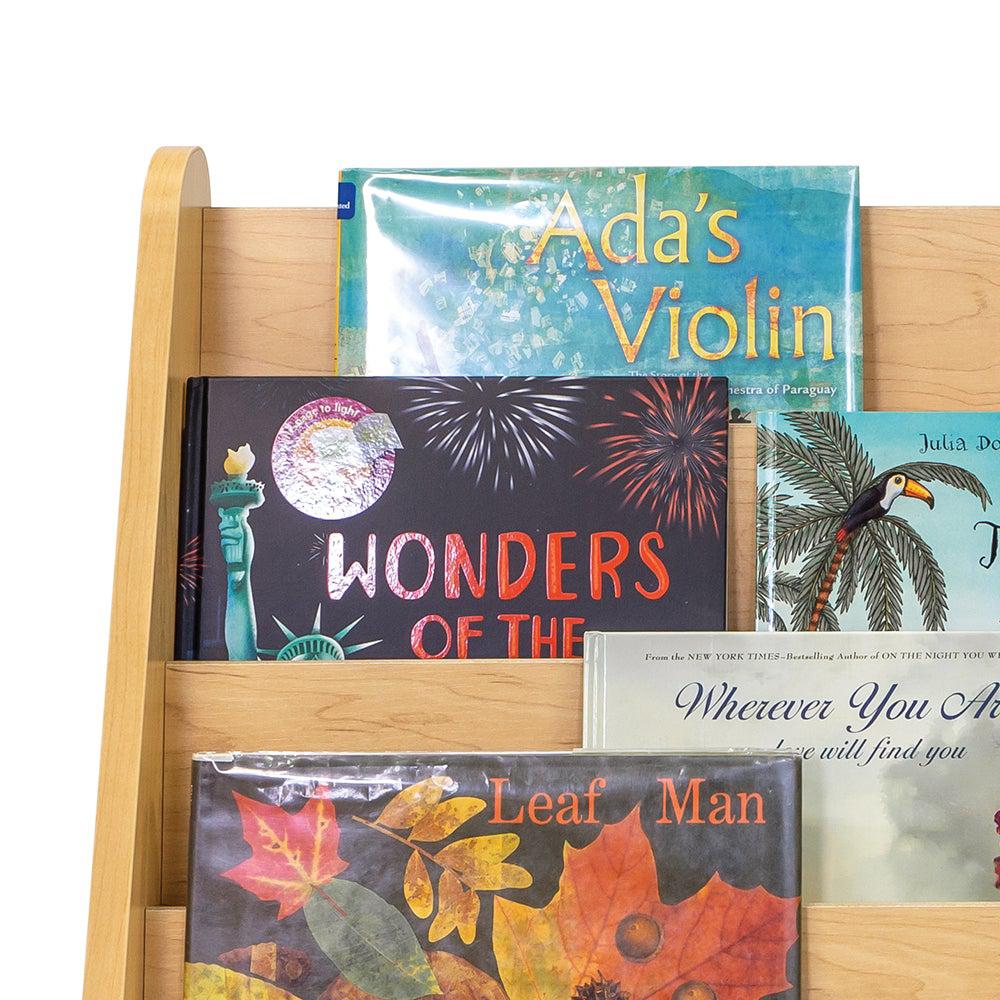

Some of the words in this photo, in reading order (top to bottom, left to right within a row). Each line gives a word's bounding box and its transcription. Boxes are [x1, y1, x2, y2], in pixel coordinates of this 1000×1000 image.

[523, 173, 741, 271] Ada's
[591, 275, 835, 363] Violin
[766, 384, 780, 395] of
[782, 384, 837, 397] Paraguay
[919, 433, 967, 454] Julia
[326, 531, 670, 600] WONDERS
[409, 614, 485, 660] OF
[645, 652, 668, 661] From
[671, 652, 685, 661] the
[687, 652, 711, 661] NEW
[715, 652, 744, 661] YORK
[837, 652, 868, 661] Author
[870, 651, 880, 660] of
[882, 651, 897, 660] ON
[901, 651, 922, 660] THE
[925, 651, 959, 660] NIGHT
[962, 651, 985, 660] YOU
[675, 681, 834, 721] Wherever
[846, 682, 932, 733] You
[820, 739, 864, 760] will
[857, 737, 921, 767] find
[919, 746, 967, 767] you
[488, 777, 606, 824] Leaf
[656, 777, 766, 824] Man
